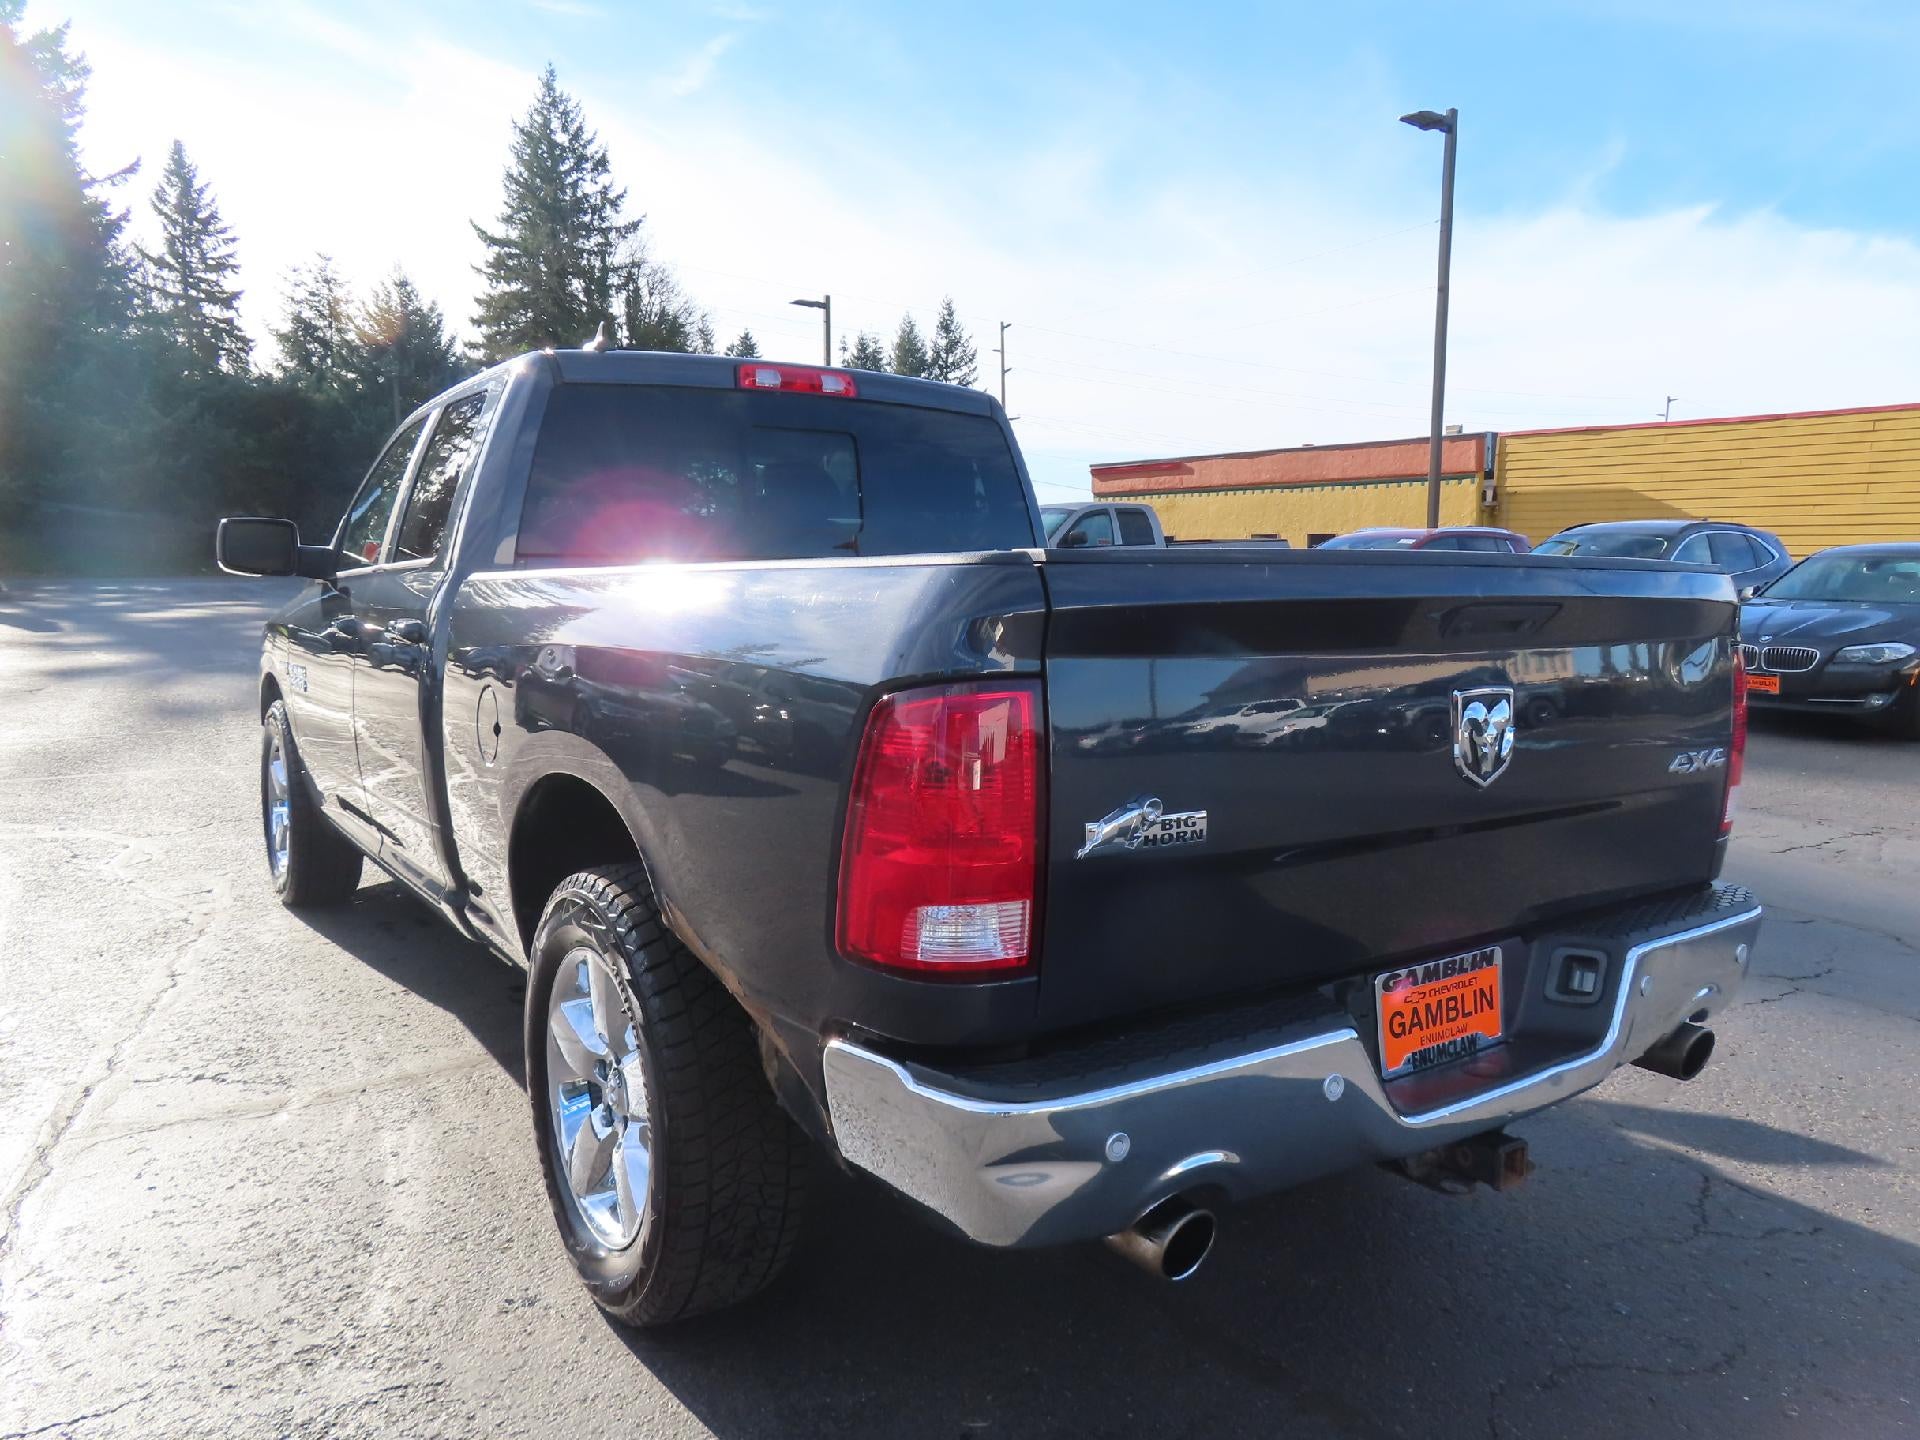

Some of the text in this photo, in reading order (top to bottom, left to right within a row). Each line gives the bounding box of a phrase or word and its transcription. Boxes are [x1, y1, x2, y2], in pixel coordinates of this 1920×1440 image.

[1160, 815, 1197, 832] BIG
[1143, 829, 1204, 847] HORN
[1382, 949, 1496, 993] GAMBLIN
[1428, 976, 1479, 998] CHEVROLET
[1388, 984, 1494, 1039] GAMBLIN
[1420, 1023, 1468, 1046] ENUMCLAW
